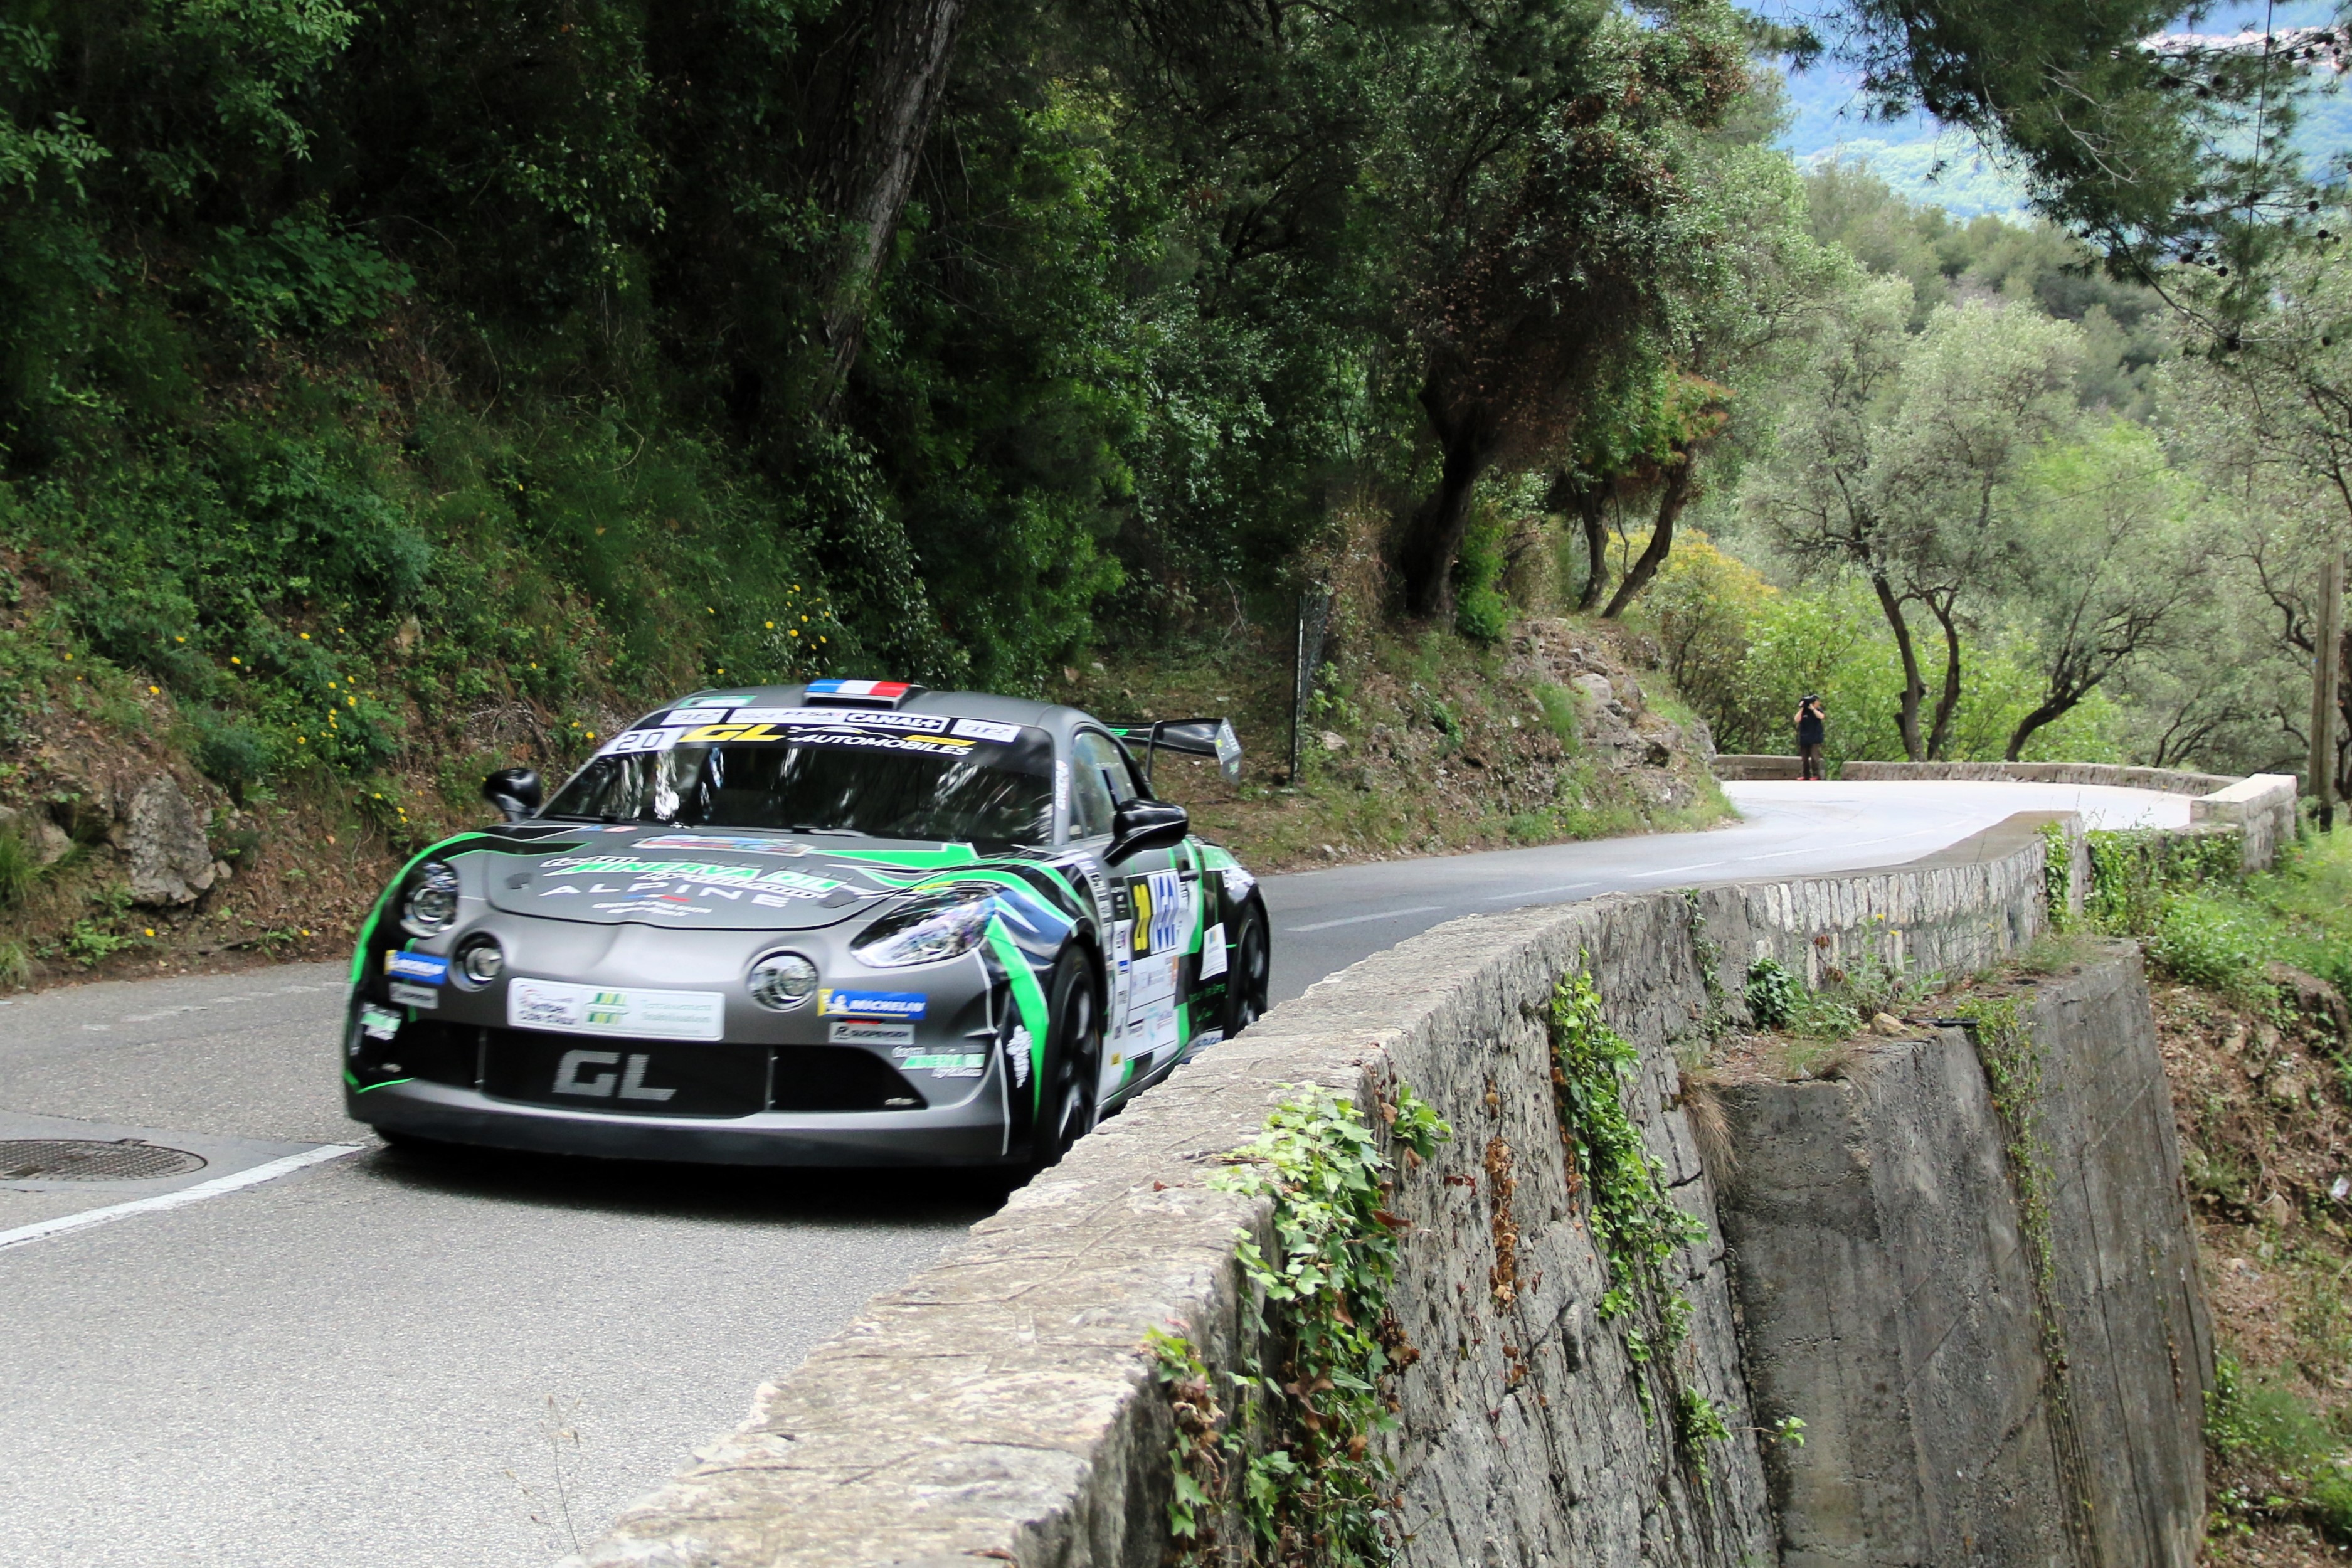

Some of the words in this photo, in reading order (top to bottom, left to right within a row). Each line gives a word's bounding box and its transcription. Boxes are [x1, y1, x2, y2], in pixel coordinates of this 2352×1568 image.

[847, 713, 941, 731] CANAL+
[617, 731, 665, 751] 20
[677, 724, 787, 743] GL
[790, 734, 974, 756] AUTOMOBILES
[542, 861, 763, 881] MINERVA
[755, 870, 848, 893] OIL
[539, 881, 791, 908] ALPINE
[847, 998, 926, 1013] MICHELIN
[551, 1049, 678, 1101] GL
